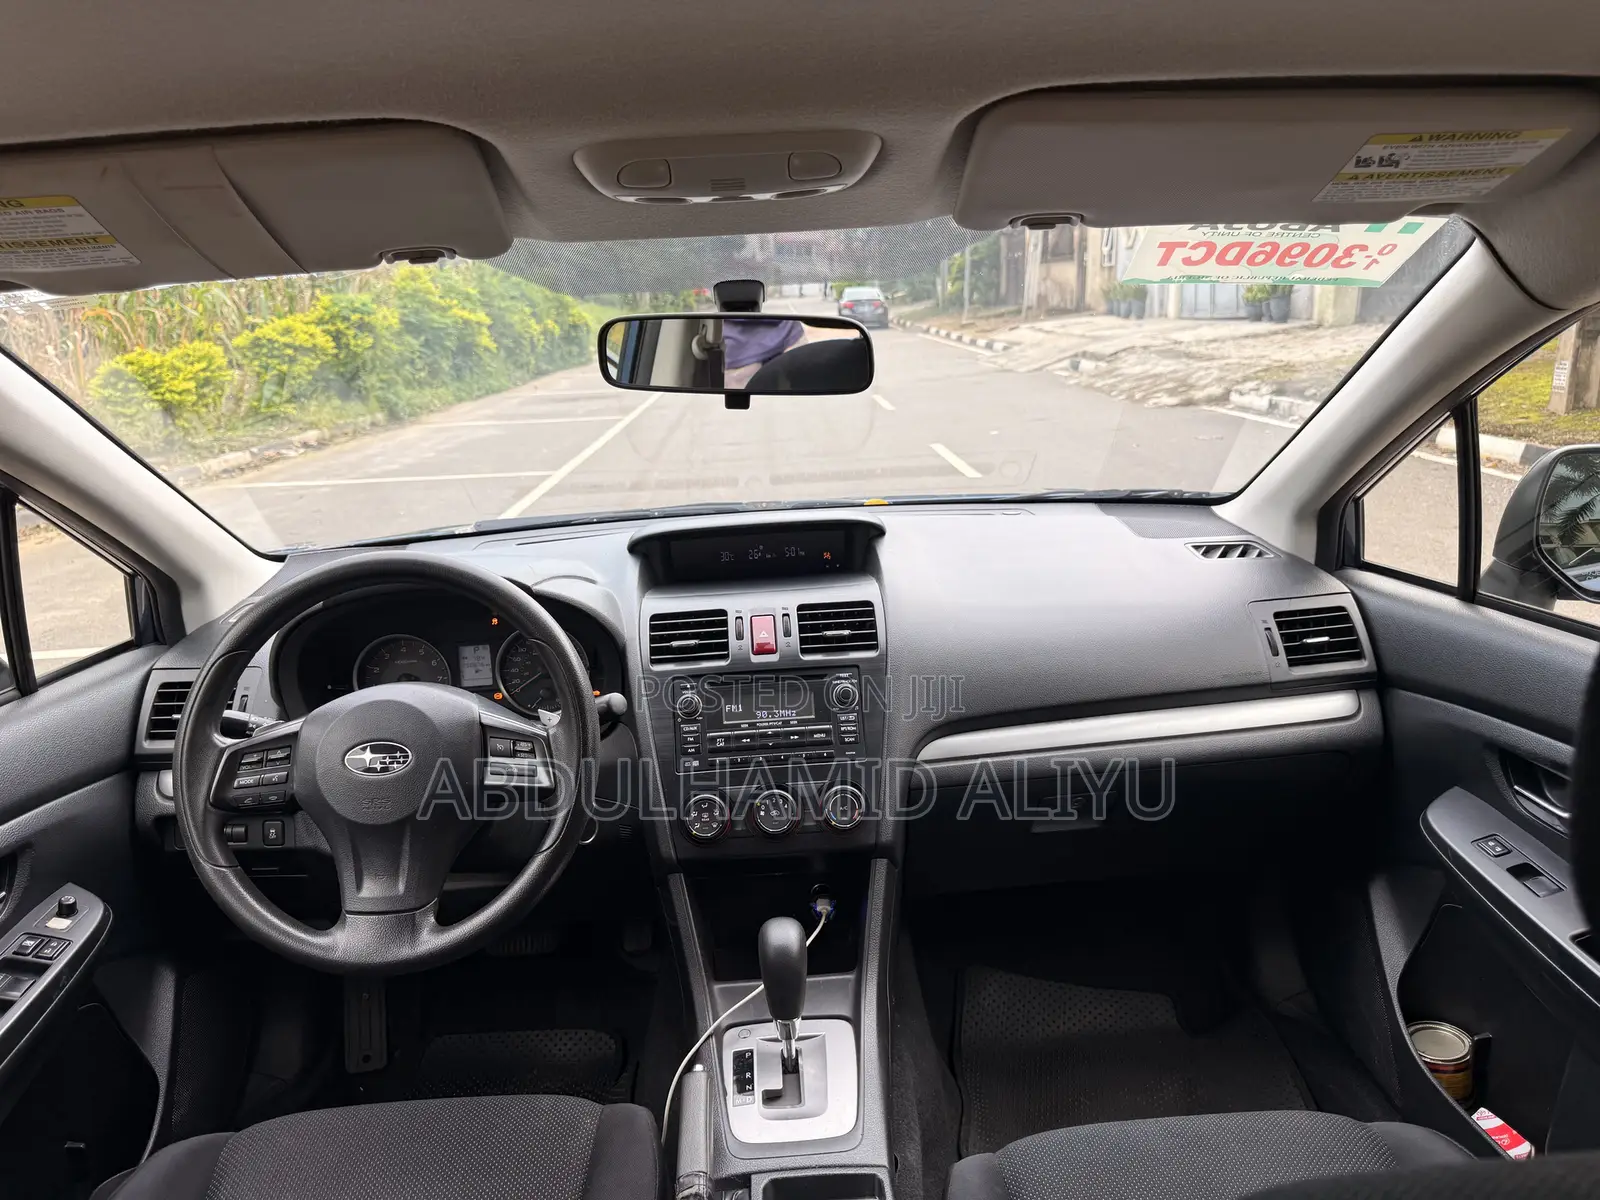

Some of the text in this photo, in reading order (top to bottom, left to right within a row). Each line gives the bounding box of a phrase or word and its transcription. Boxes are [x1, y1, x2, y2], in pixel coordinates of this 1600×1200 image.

[1428, 131, 1522, 142] WARNING
[1364, 167, 1507, 181] AVERTISSEMENT
[725, 703, 742, 713] FM1
[756, 709, 797, 719] 90.3MHz
